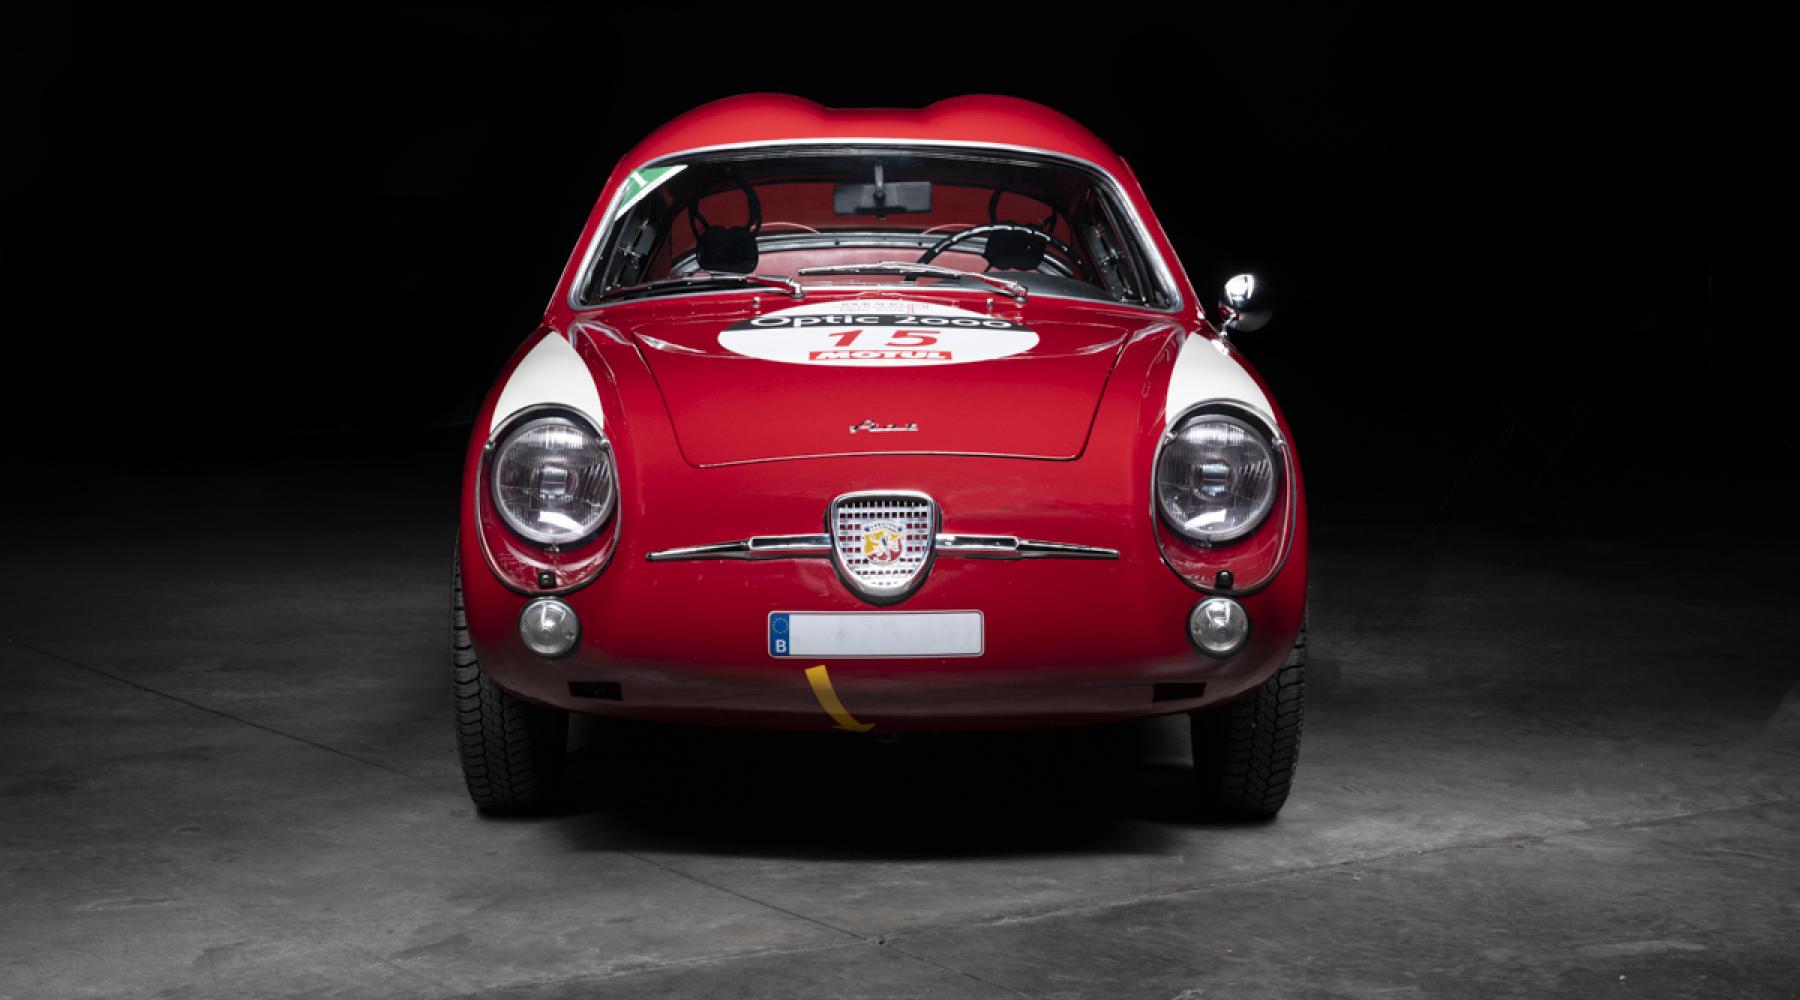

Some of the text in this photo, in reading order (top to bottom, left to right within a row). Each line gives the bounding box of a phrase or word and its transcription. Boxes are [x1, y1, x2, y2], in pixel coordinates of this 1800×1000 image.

[750, 314, 1012, 328] Optic 2000
[828, 329, 941, 348] 15
[815, 351, 946, 360] MOTUL
[775, 639, 786, 653] B
